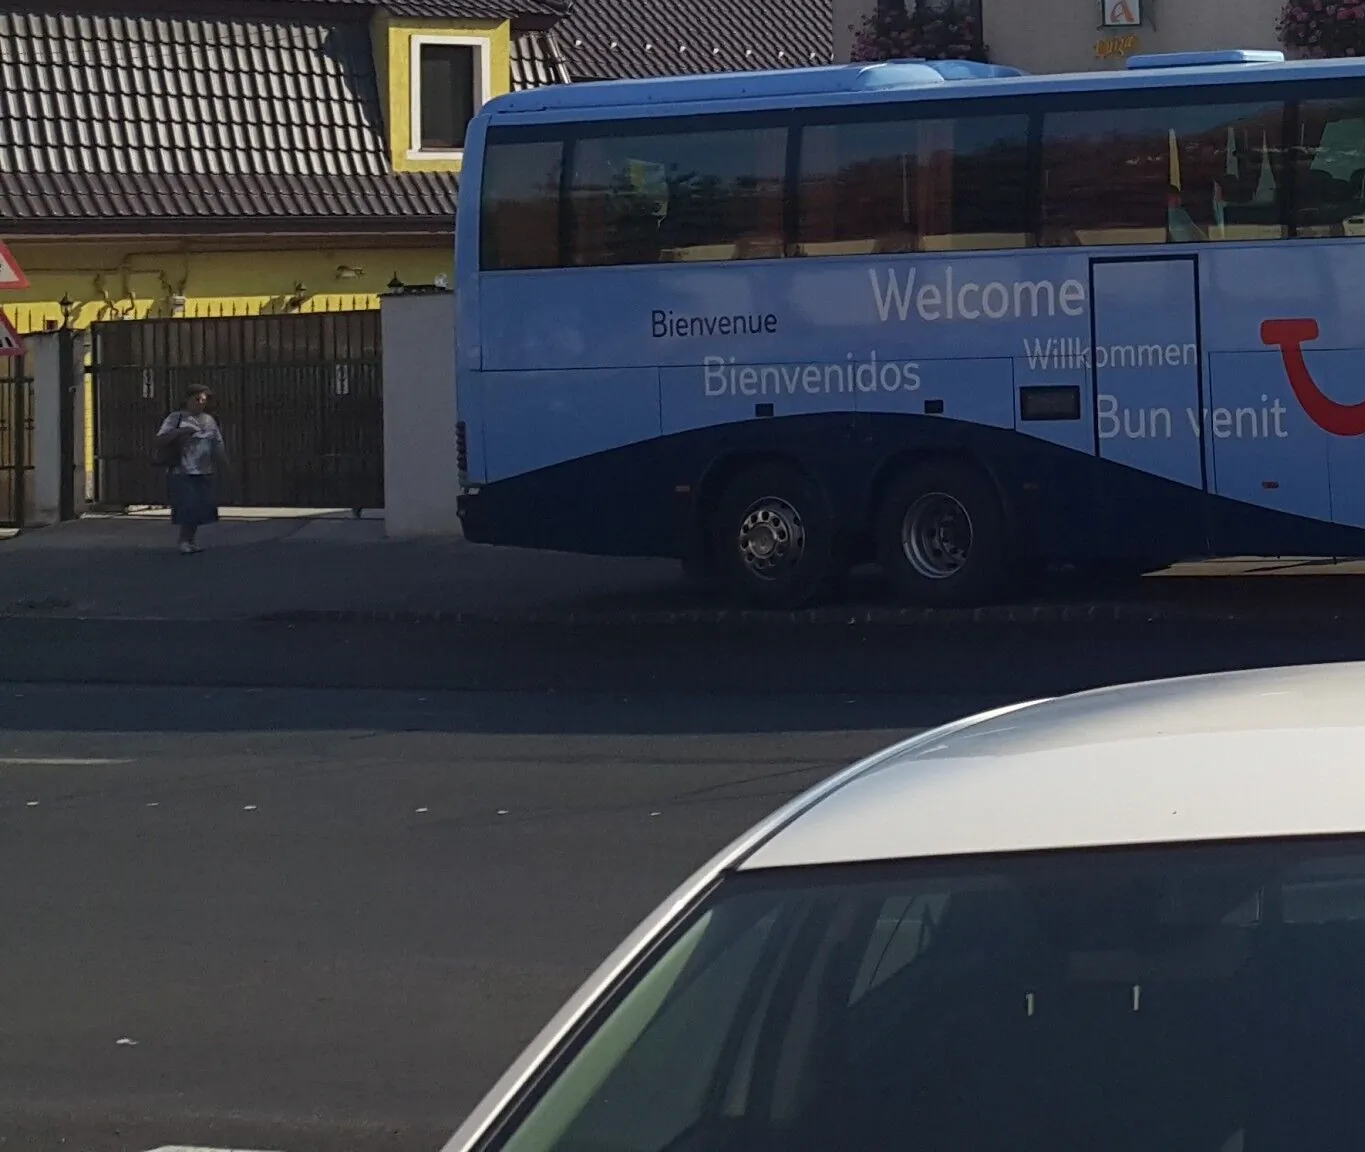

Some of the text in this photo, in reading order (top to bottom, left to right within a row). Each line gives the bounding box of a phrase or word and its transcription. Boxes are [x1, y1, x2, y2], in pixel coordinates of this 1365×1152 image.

[868, 266, 1085, 321] Welcome
[650, 309, 778, 338] Bienvenue
[703, 350, 921, 397] Bienvenidos
[1023, 337, 1198, 370] Willkommen
[1097, 393, 1289, 439] Bun venit
